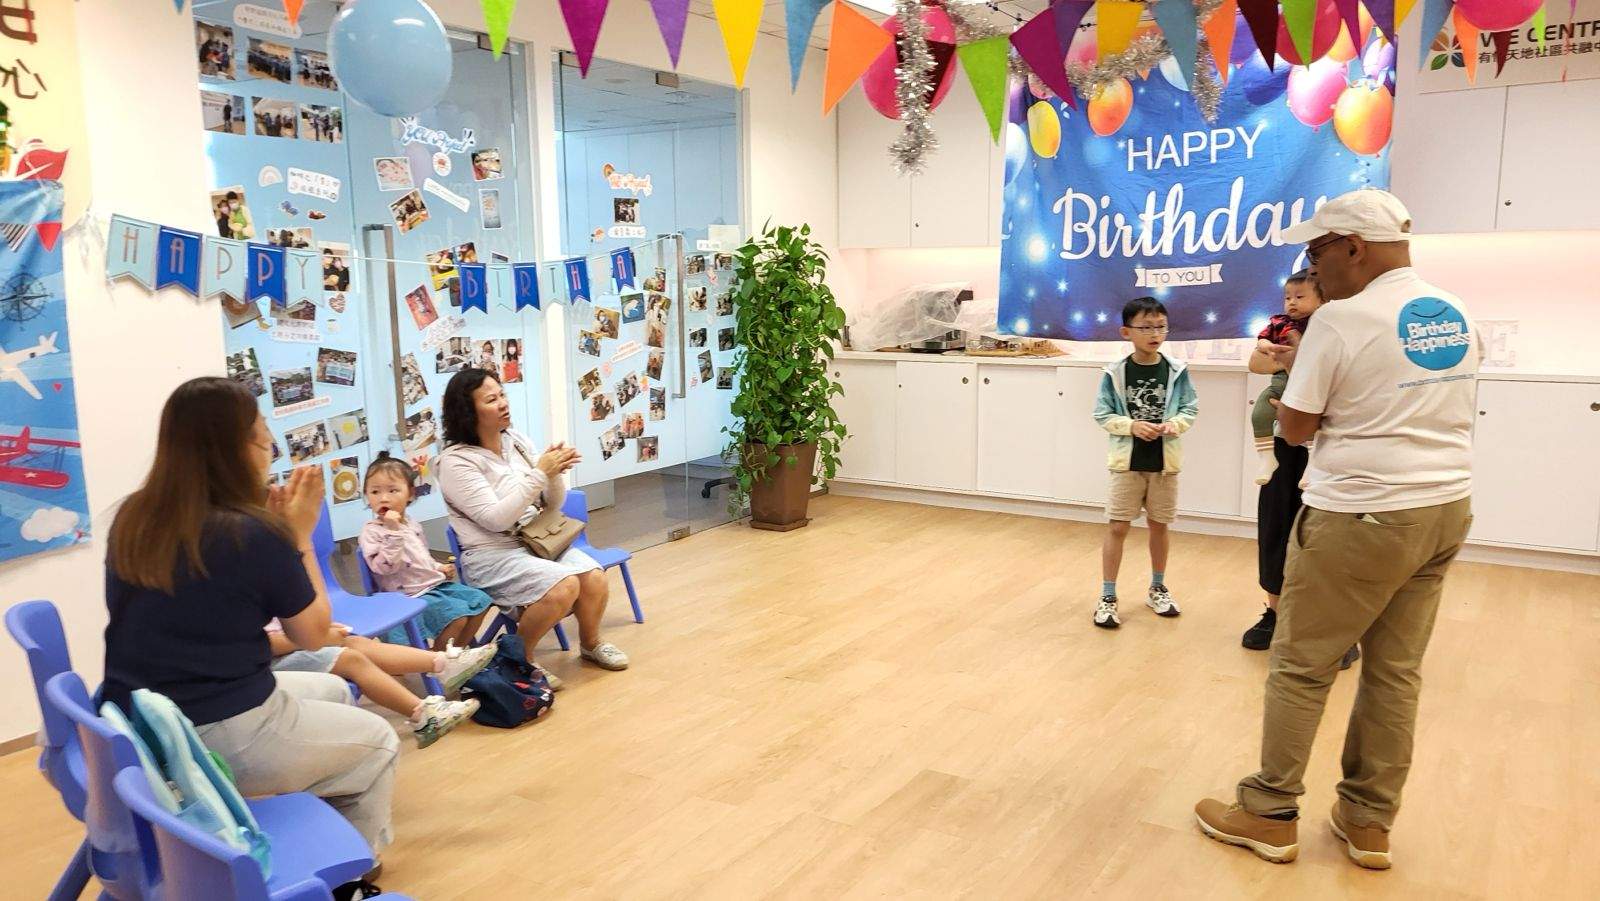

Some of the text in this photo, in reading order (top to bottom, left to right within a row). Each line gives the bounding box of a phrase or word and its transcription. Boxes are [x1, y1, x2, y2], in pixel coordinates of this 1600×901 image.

[1127, 123, 1264, 172] HAPPY
[122, 226, 310, 290] HAPPY
[1152, 269, 1205, 283] TO YOU
[1406, 320, 1462, 339] Birthday
[1399, 332, 1471, 354] Happiness
